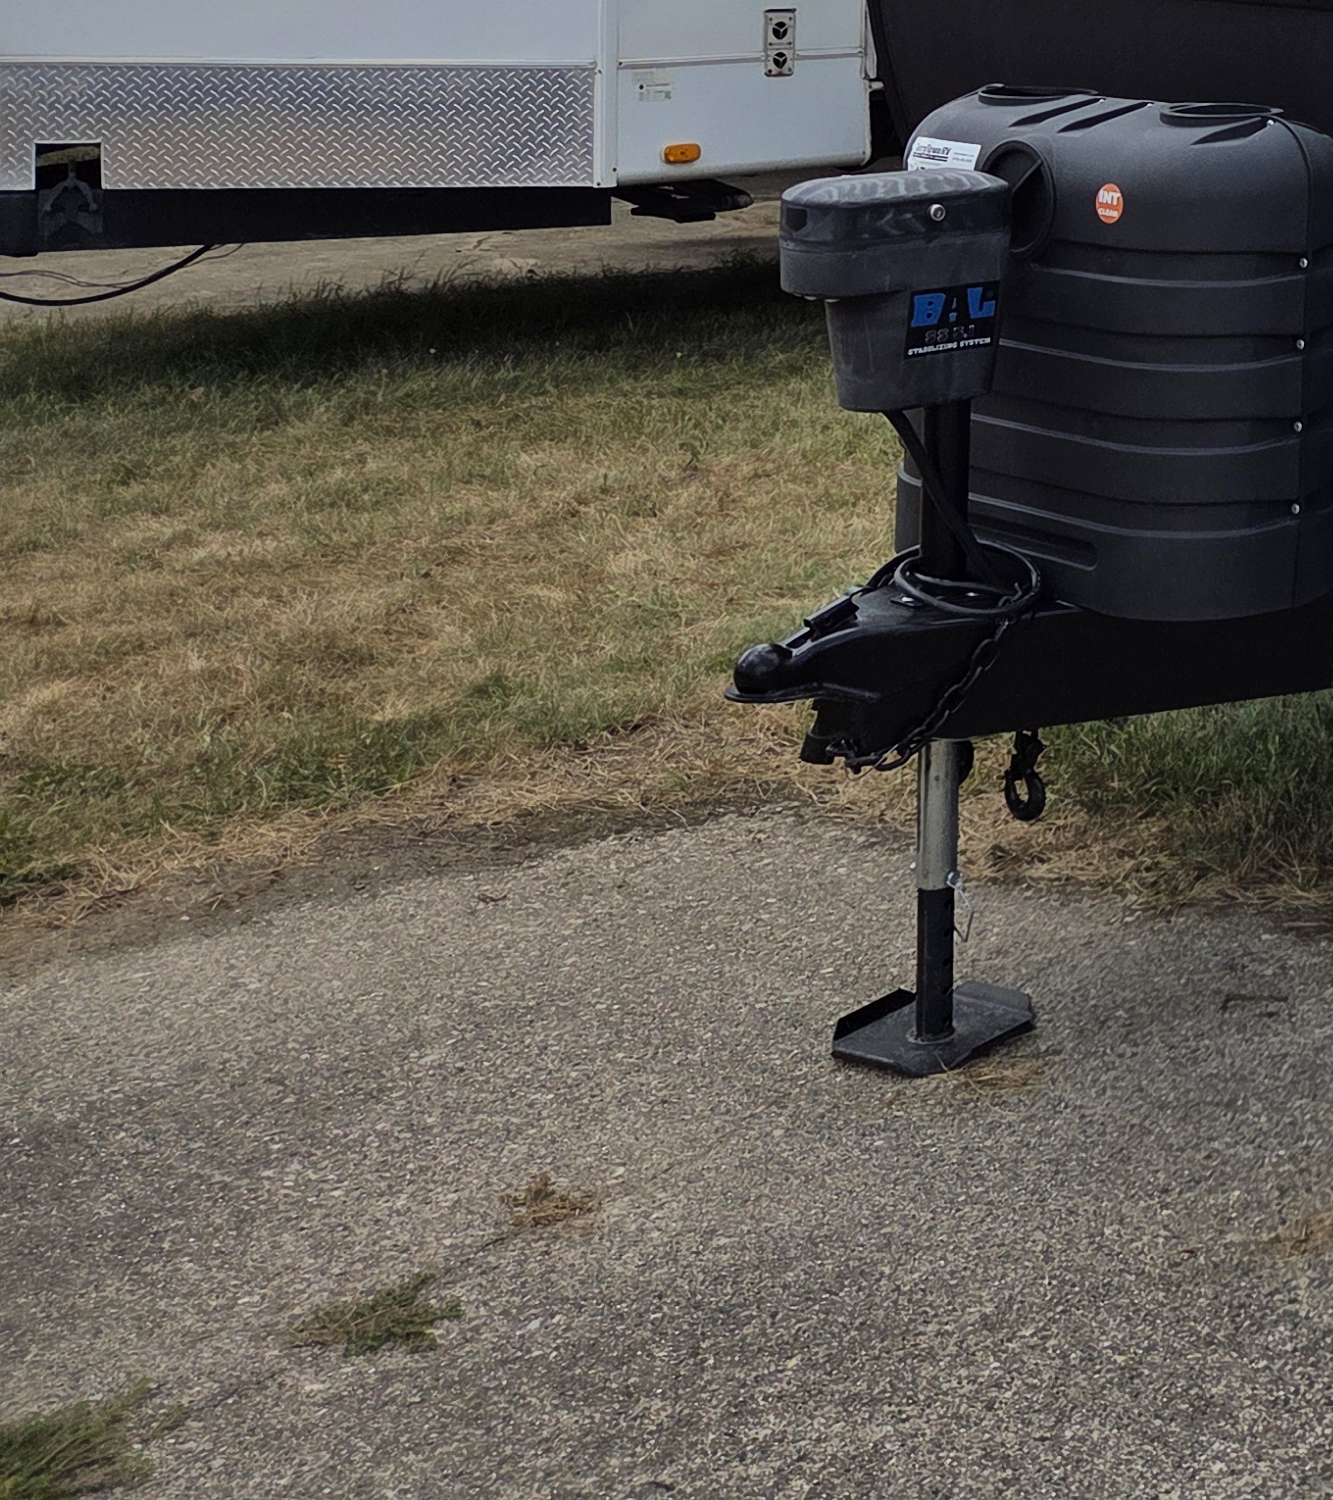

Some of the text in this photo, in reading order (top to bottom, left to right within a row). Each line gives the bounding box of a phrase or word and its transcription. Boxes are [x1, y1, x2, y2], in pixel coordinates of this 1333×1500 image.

[1098, 189, 1121, 206] INT
[911, 287, 996, 328] BAL
[959, 337, 991, 348] SYSTEM
